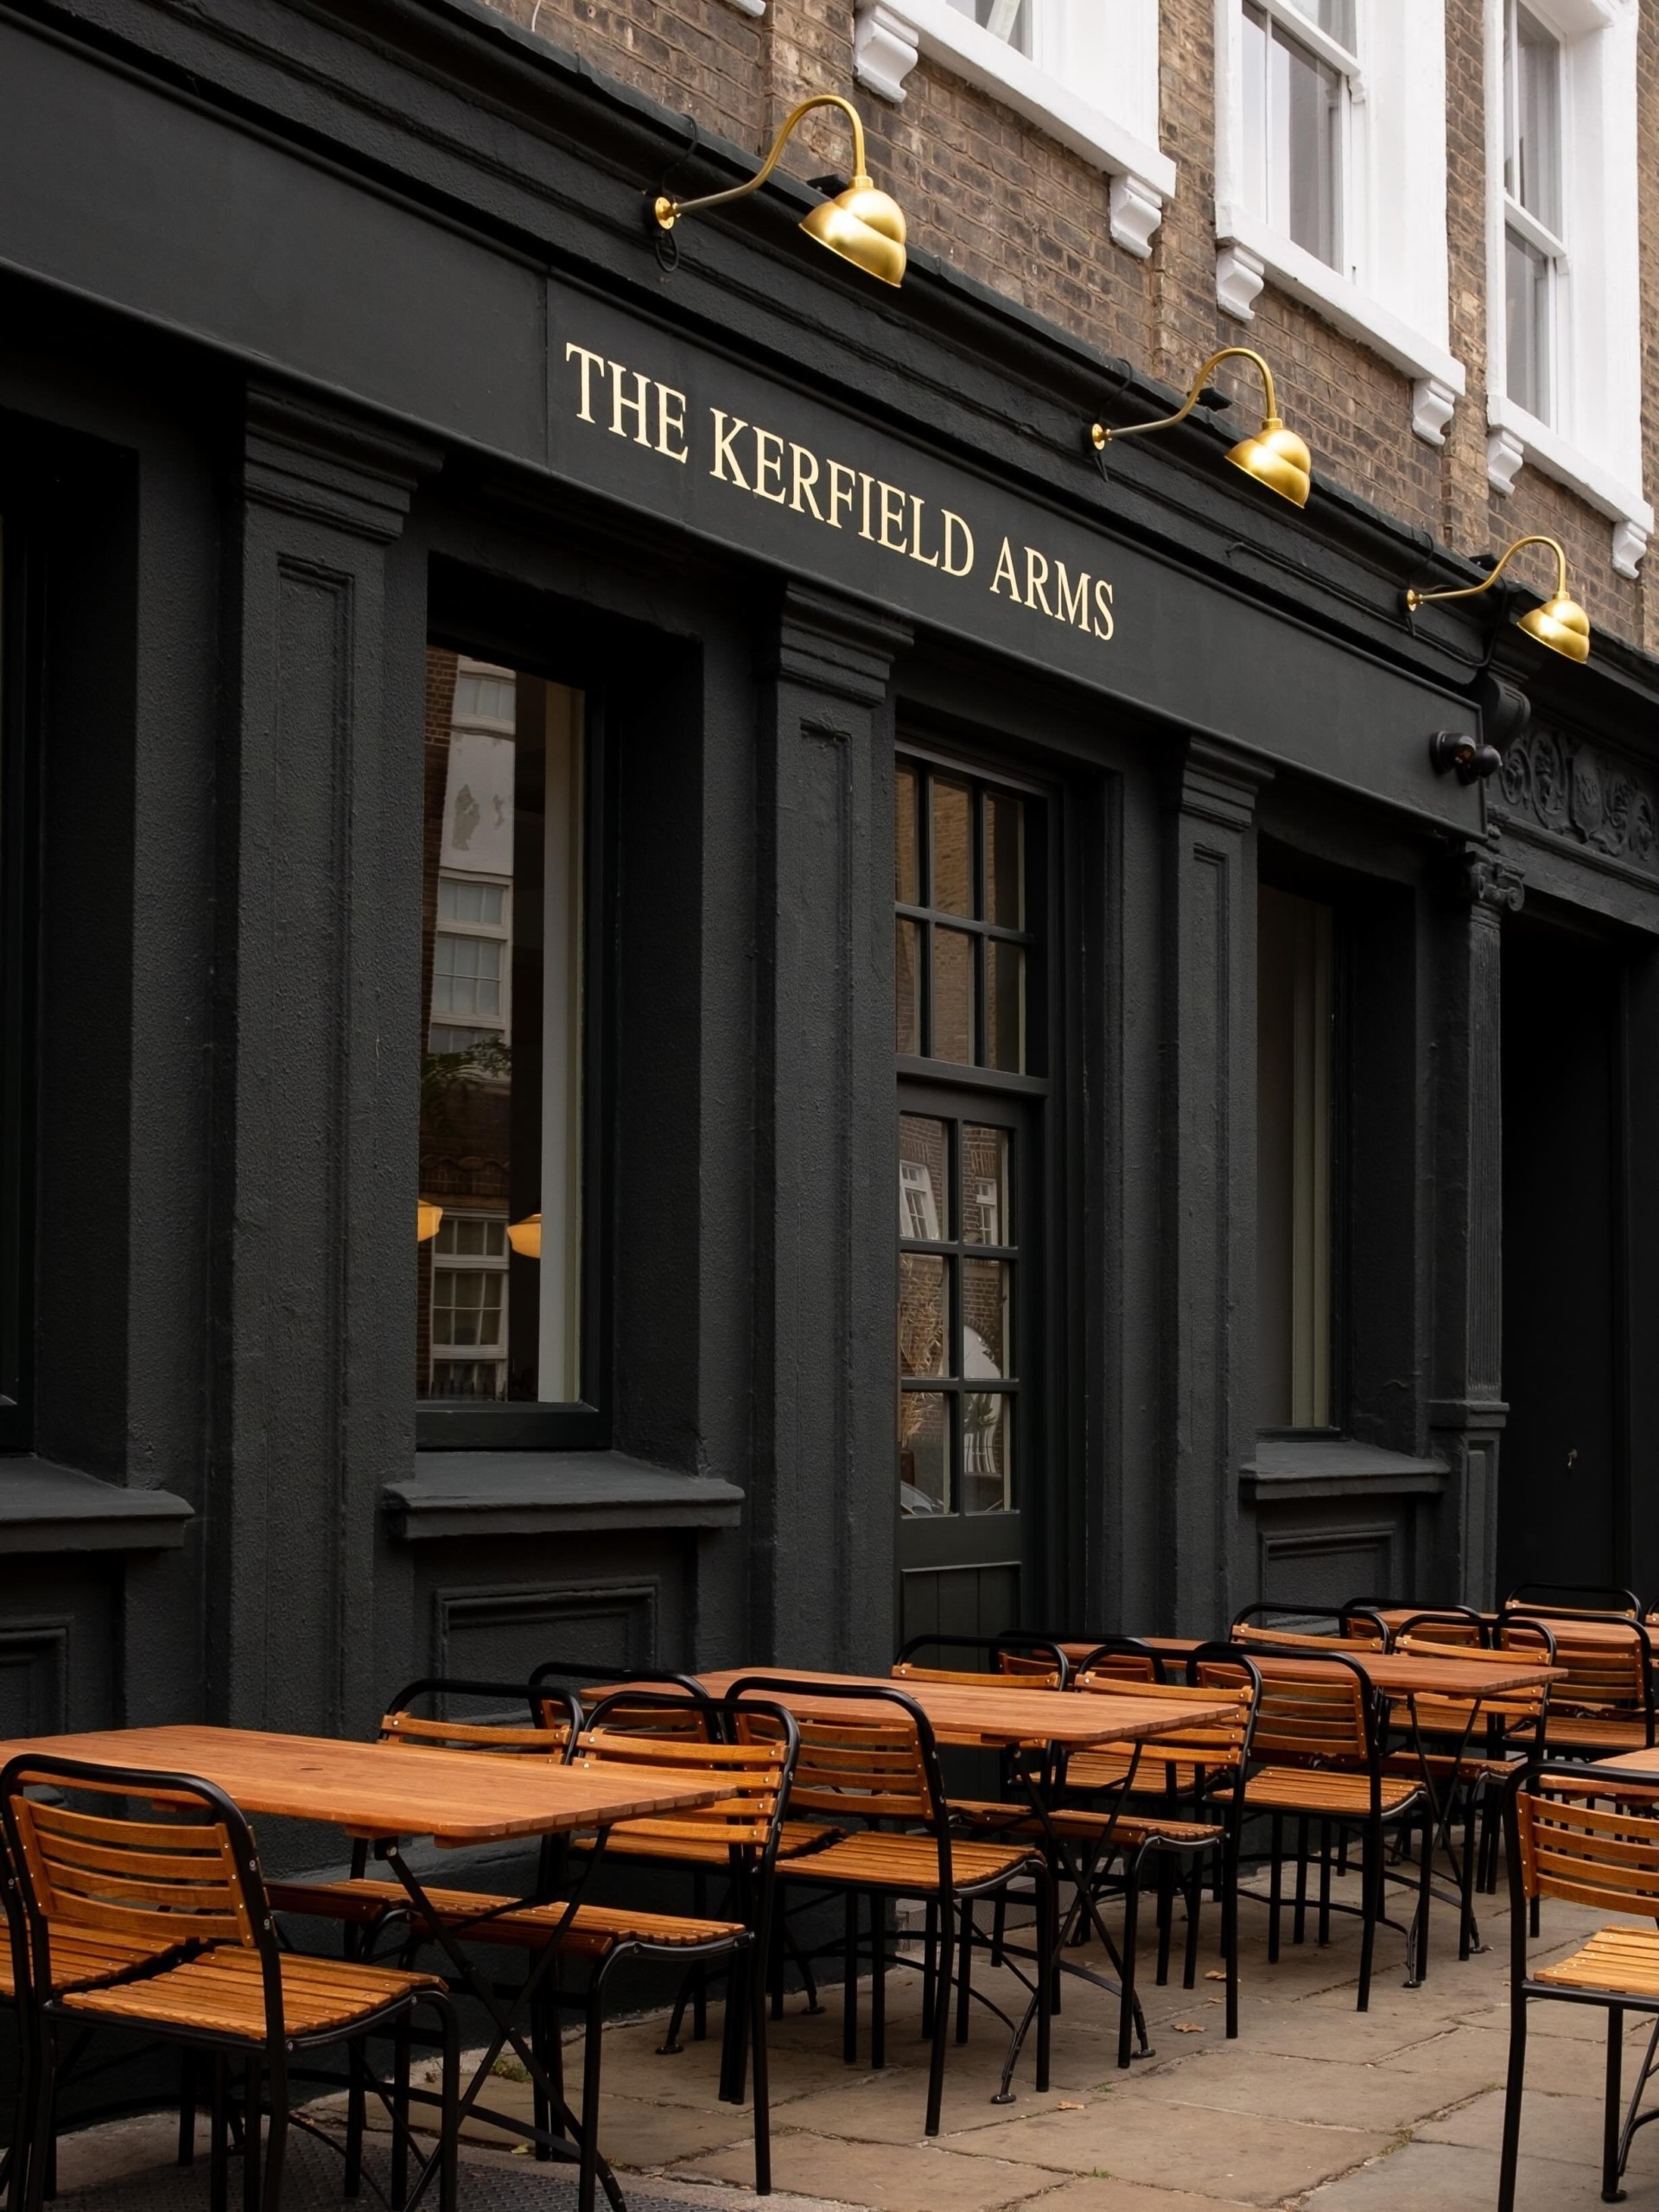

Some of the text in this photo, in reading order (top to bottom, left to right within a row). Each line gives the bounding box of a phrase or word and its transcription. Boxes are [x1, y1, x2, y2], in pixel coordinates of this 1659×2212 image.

[565, 341, 1115, 641] THE KERFIELD ARMS
